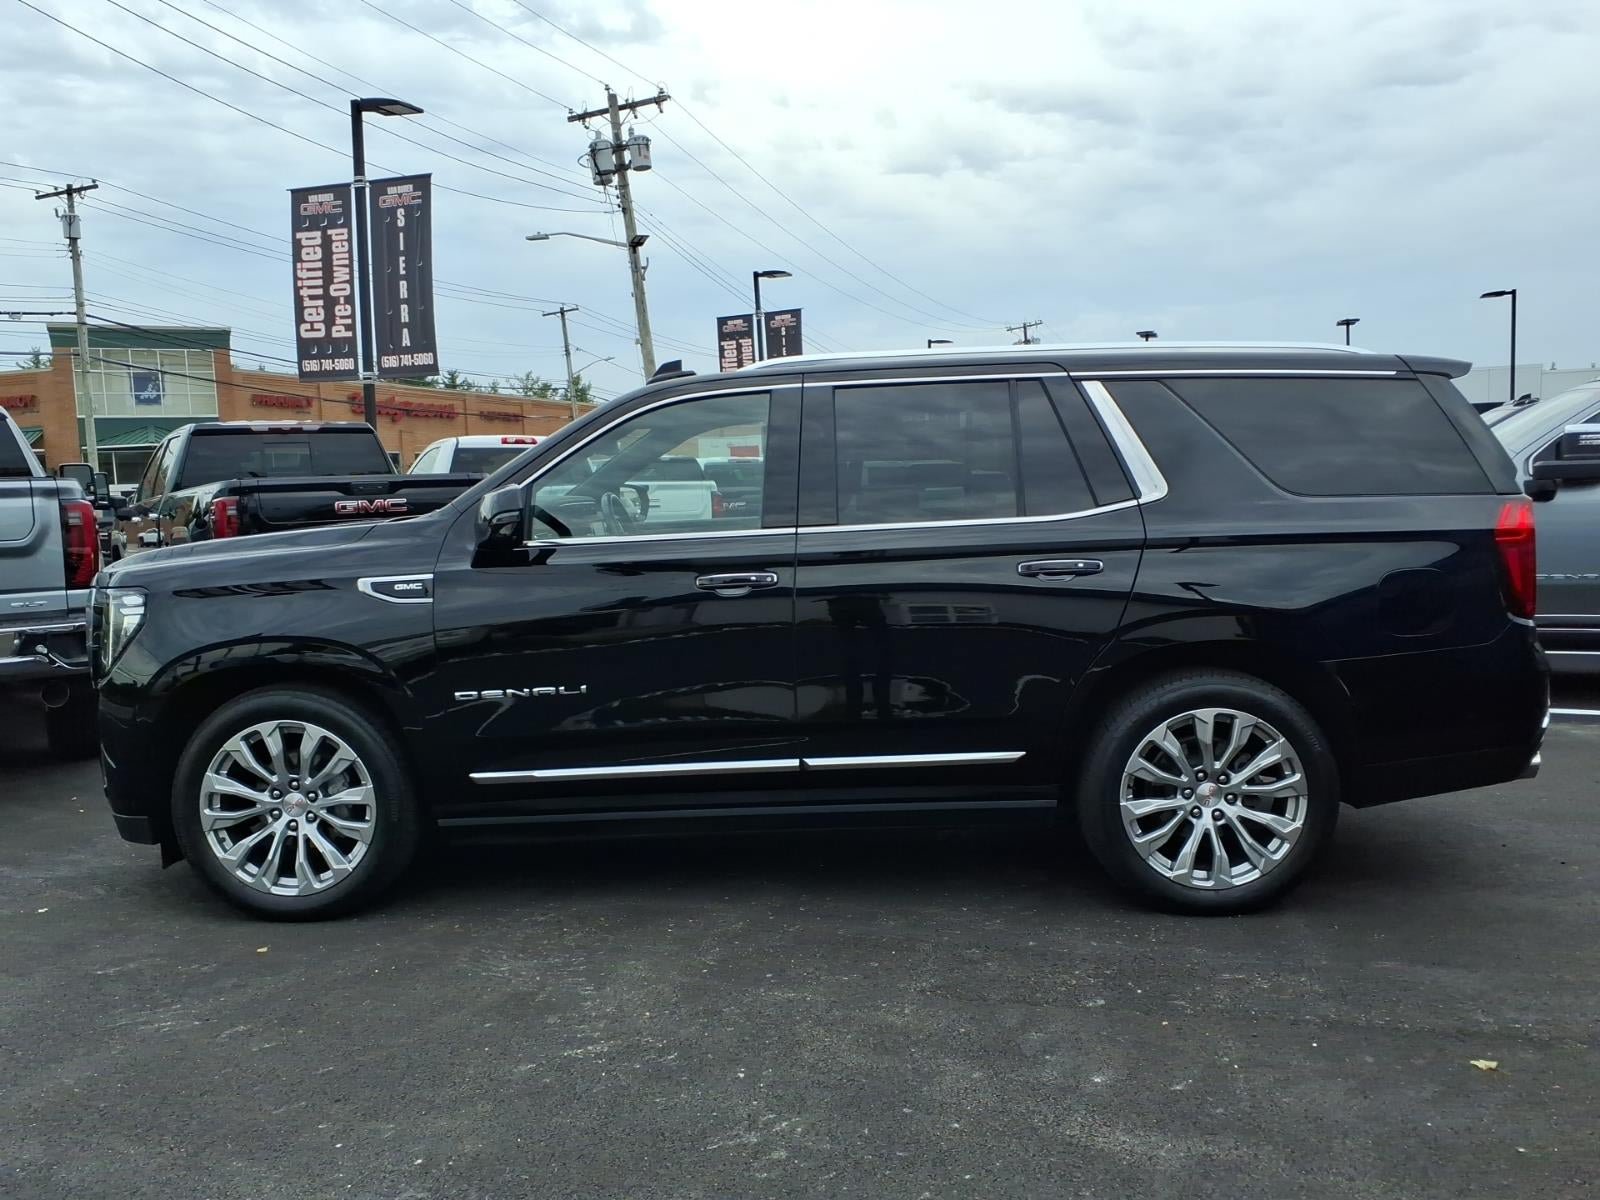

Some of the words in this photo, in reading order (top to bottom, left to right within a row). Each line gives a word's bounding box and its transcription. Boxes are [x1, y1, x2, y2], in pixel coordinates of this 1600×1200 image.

[300, 200, 342, 215] GMC
[379, 192, 422, 208] GMC
[296, 230, 326, 339] Certified
[327, 227, 353, 338] Pre-Owned
[302, 360, 320, 372] (516)
[381, 355, 399, 368] (516)
[334, 498, 407, 514] GMC
[394, 583, 423, 591] GMC
[454, 684, 587, 700] DENALI
